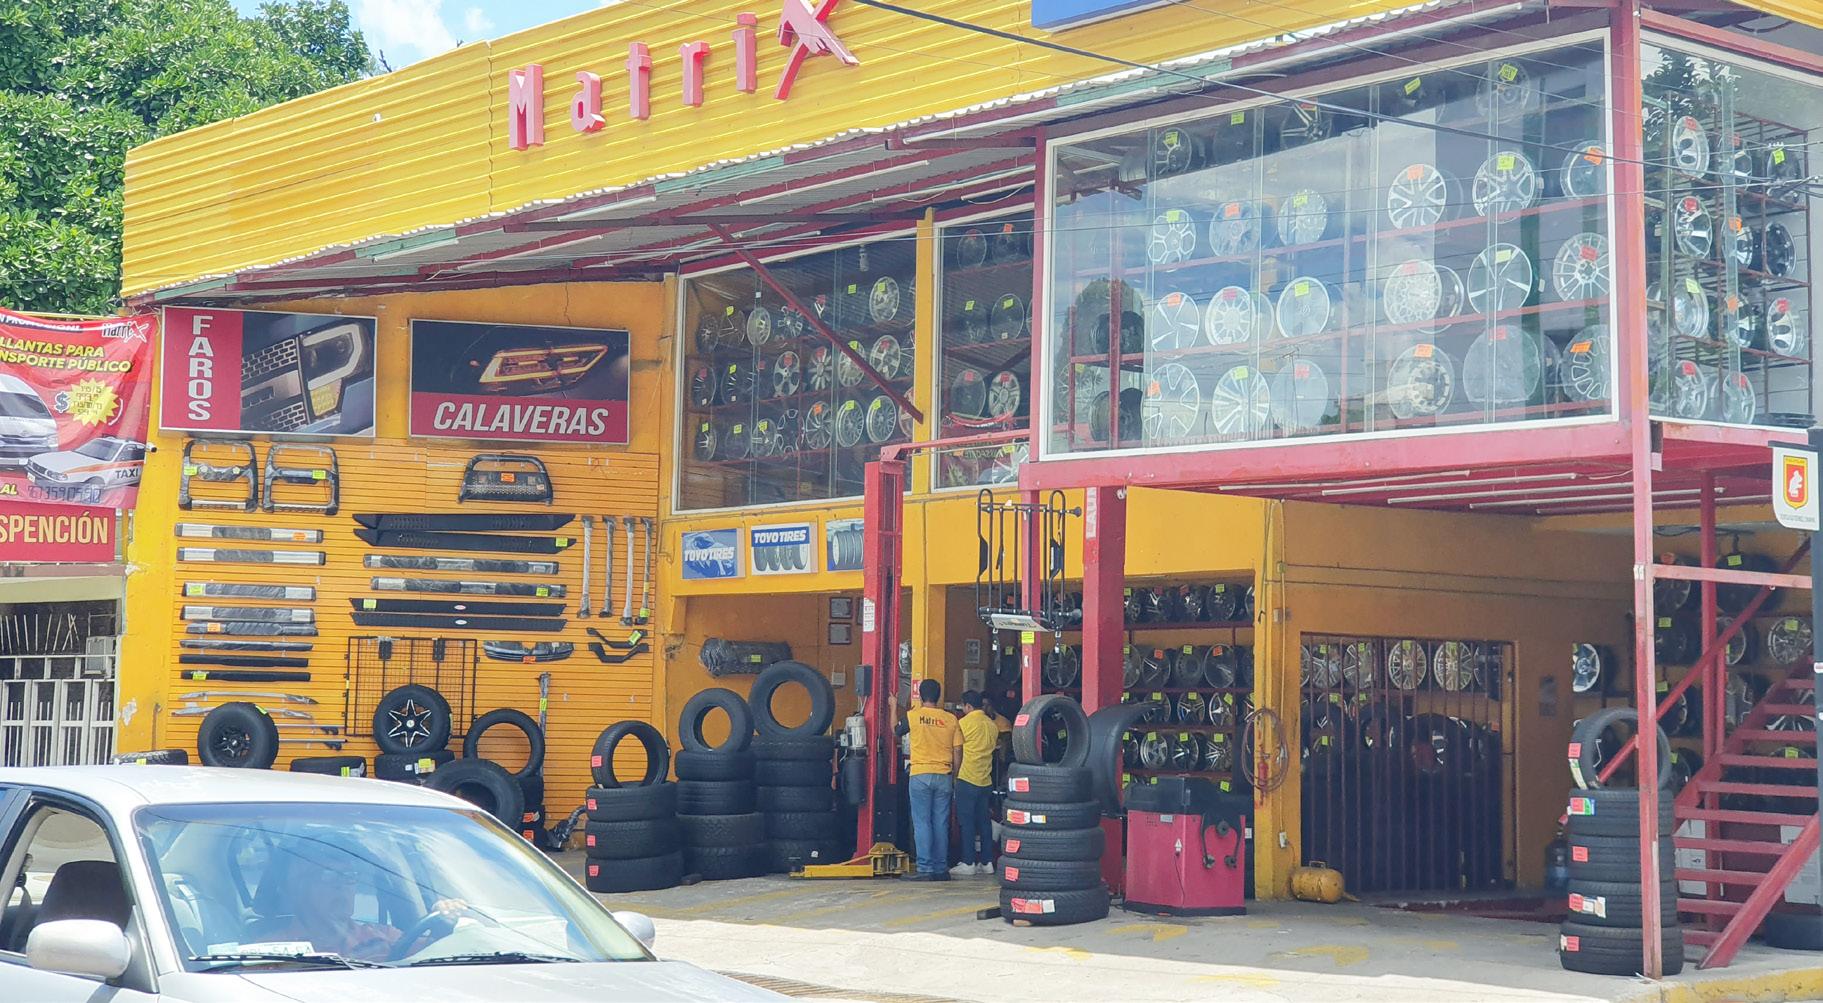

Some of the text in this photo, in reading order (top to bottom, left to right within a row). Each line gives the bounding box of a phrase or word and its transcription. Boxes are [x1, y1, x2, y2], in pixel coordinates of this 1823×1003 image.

[0, 336, 105, 358] LLANTAS PARA
[0, 350, 132, 373] NSPORTE PÚBLICO
[188, 315, 214, 421] FAROS
[433, 401, 609, 436] CALAVERAS
[116, 468, 139, 479] TAXI
[0, 511, 108, 544] SPENCIÓN
[754, 530, 807, 544] TOYO TIRES
